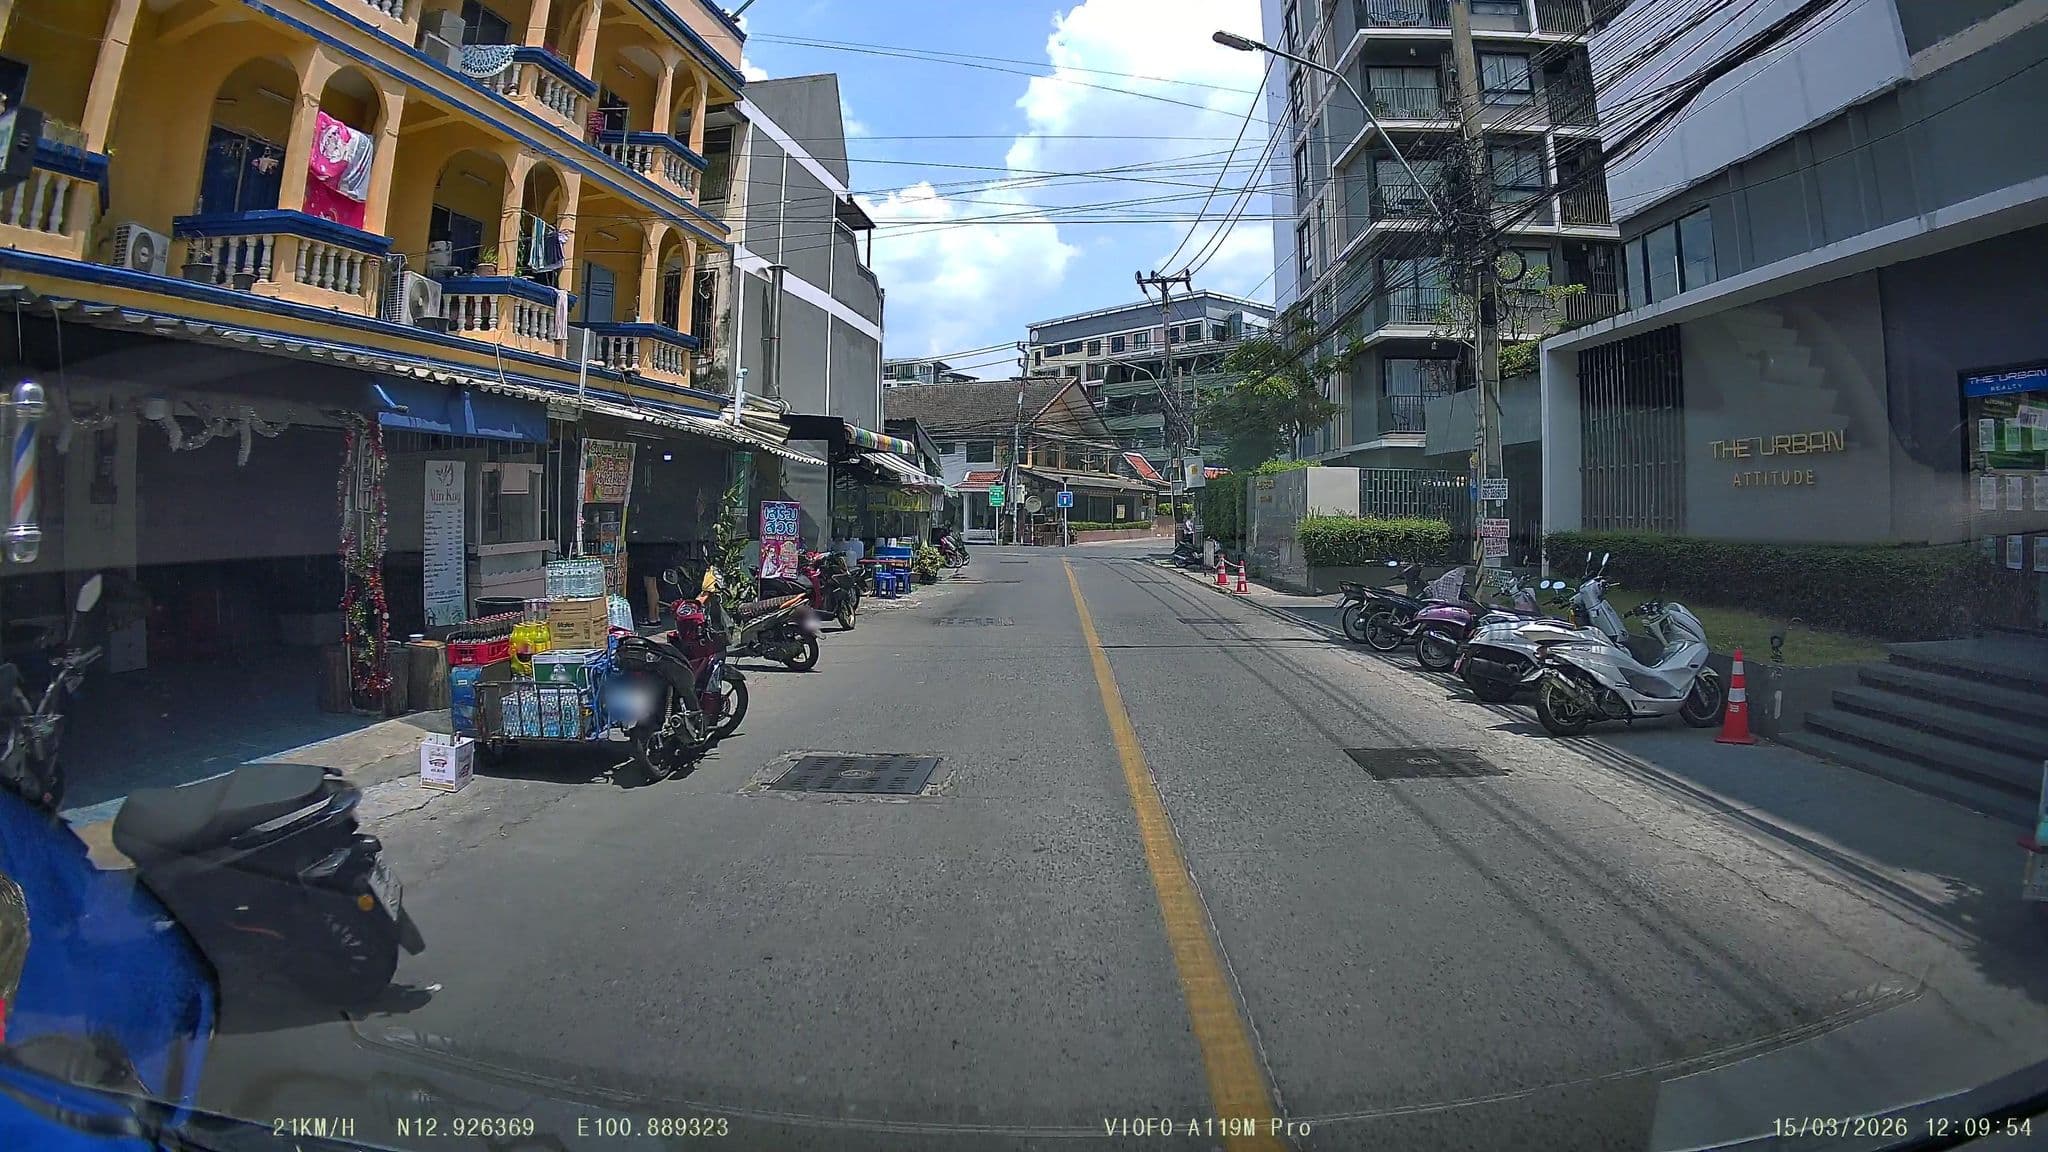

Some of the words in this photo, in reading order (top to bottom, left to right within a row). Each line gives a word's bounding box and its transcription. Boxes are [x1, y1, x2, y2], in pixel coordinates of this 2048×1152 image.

[1968, 374, 1995, 385] THE
[1998, 368, 2047, 382] URBAN
[1708, 438, 1752, 459] THE
[1757, 429, 1845, 457] URBAN
[1732, 468, 1816, 488] ATTITUDE
[764, 503, 797, 520] เสริม
[765, 521, 797, 535] สวย
